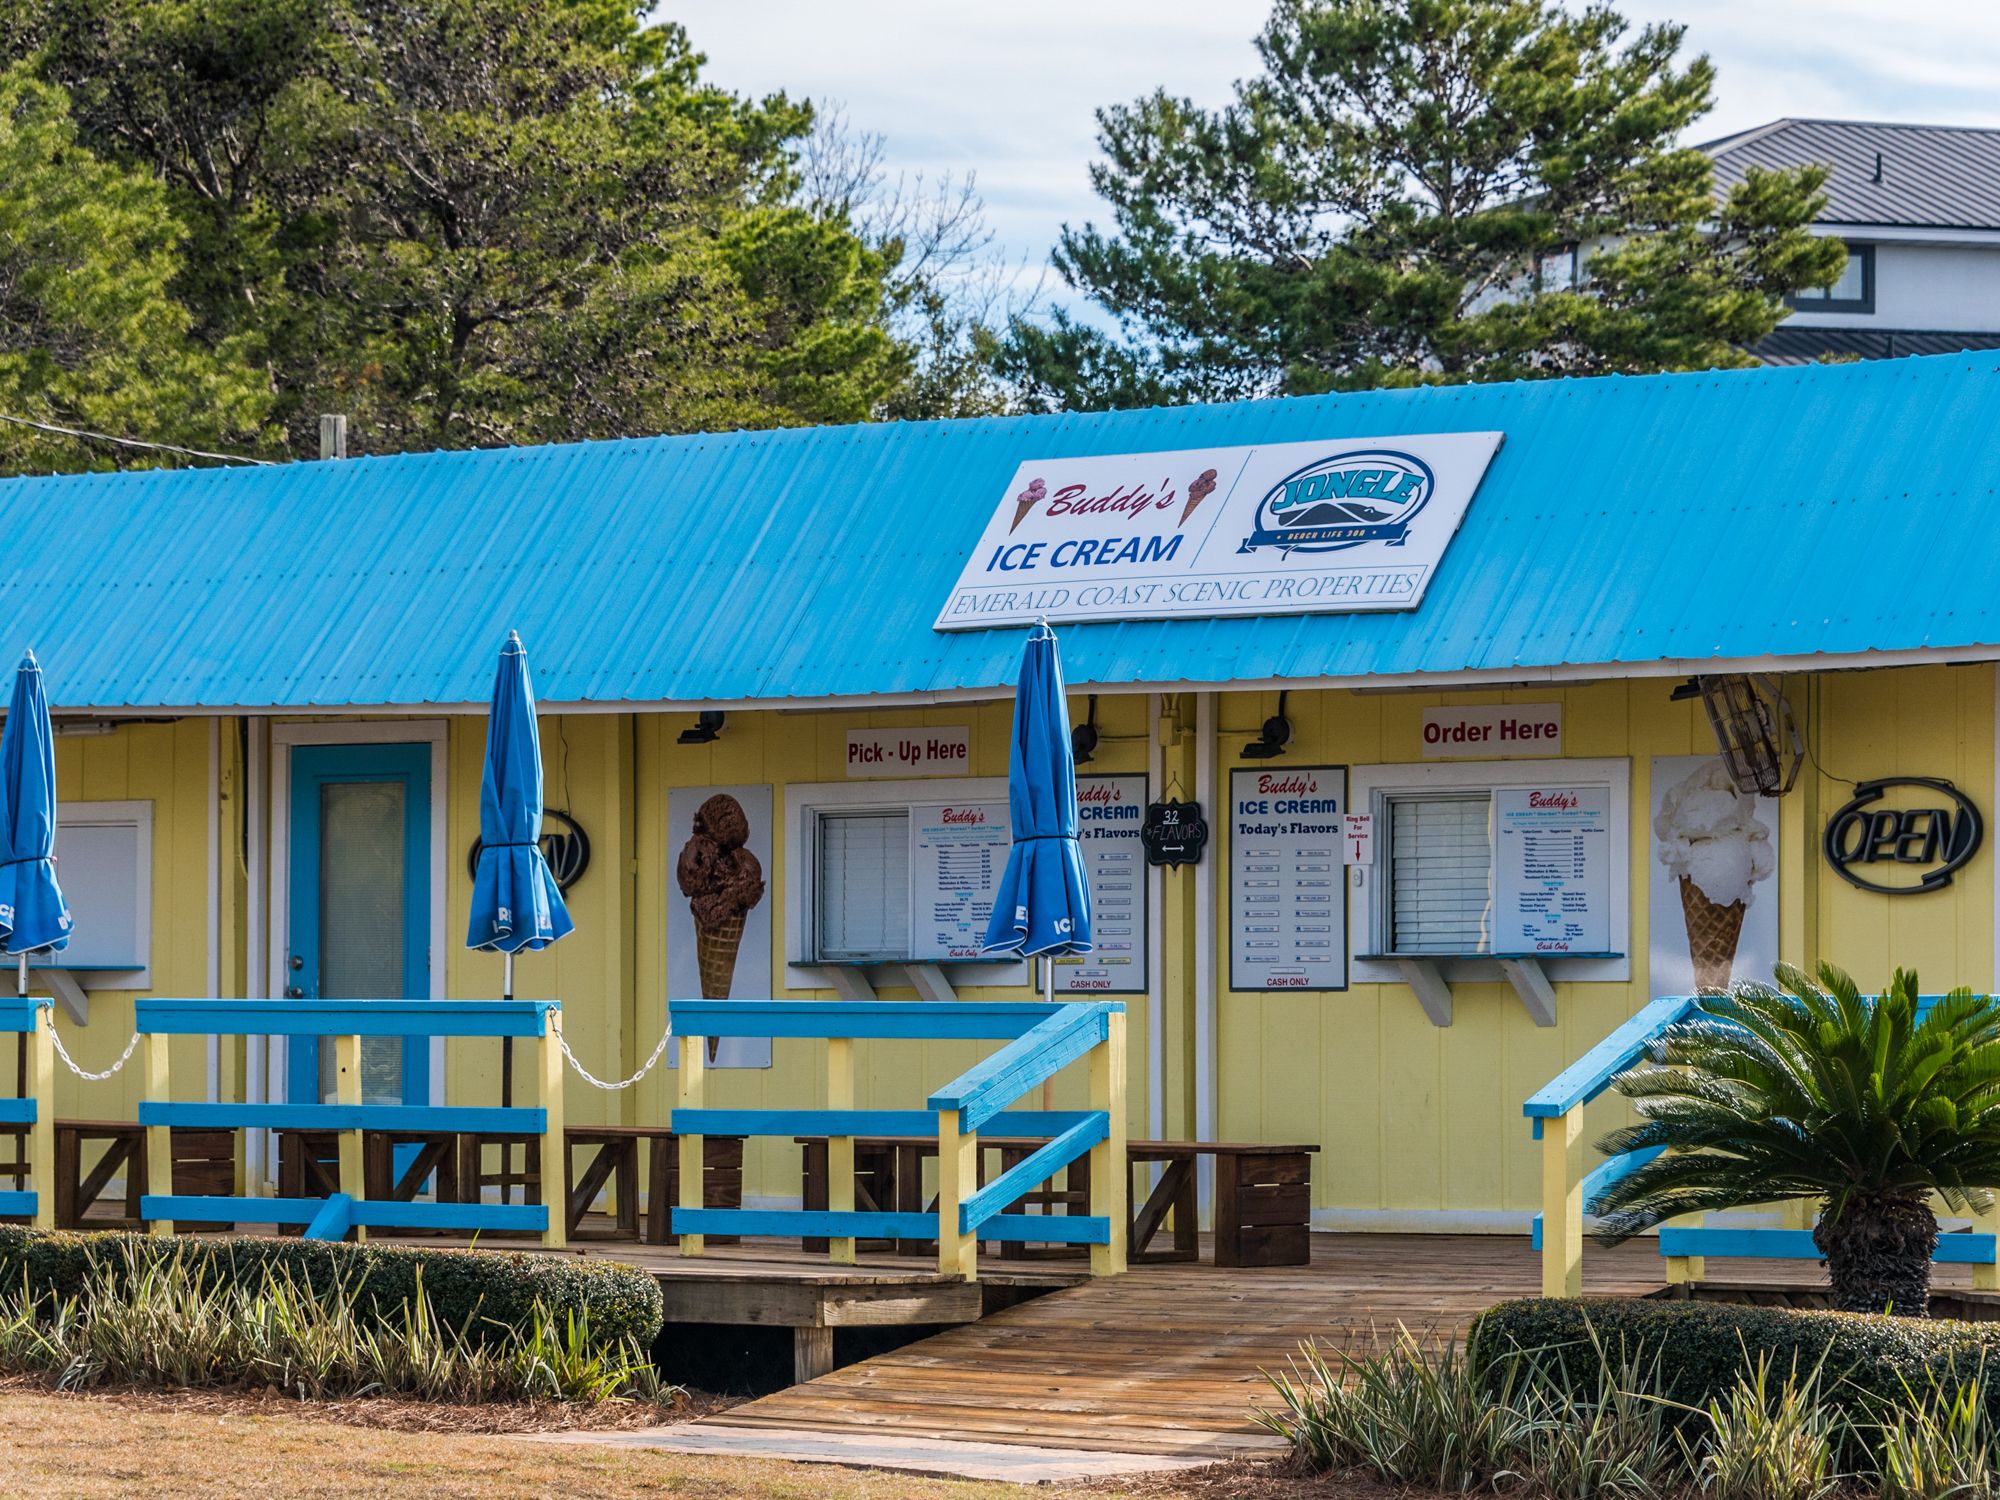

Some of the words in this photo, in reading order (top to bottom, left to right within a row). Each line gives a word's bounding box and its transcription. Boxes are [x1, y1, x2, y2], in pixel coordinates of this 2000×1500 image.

[1046, 478, 1176, 520] Buddy's
[1272, 470, 1425, 511] JONGLE
[986, 542, 1047, 572] ICE
[1050, 534, 1184, 567] CREAM
[952, 589, 1070, 614] EMERALD
[1077, 584, 1162, 606] COAST
[1163, 580, 1260, 603] SCENIC
[1261, 573, 1418, 598] PROPERTIES
[1424, 722, 1492, 743] Order
[1501, 719, 1558, 740] Here
[849, 742, 883, 762] Pick
[899, 741, 921, 765] Up
[927, 740, 966, 759] Here
[1076, 782, 1121, 806] uddy's
[1258, 773, 1317, 798] Buddy's
[1239, 801, 1268, 814] ICE
[1274, 800, 1336, 814] CREAM
[1529, 792, 1578, 810] Buddy's
[943, 808, 985, 826] Buddy's
[1080, 806, 1138, 820] CREAM
[1164, 810, 1179, 822] 32
[1094, 828, 1140, 838] Flavors
[1152, 823, 1200, 840] FLAVORS
[1239, 823, 1287, 837] Today's
[1290, 823, 1338, 834] Flavors
[1832, 808, 1964, 864] OPEN
[965, 950, 977, 958] Only
[1537, 942, 1552, 950] Cash
[1555, 942, 1568, 951] Only
